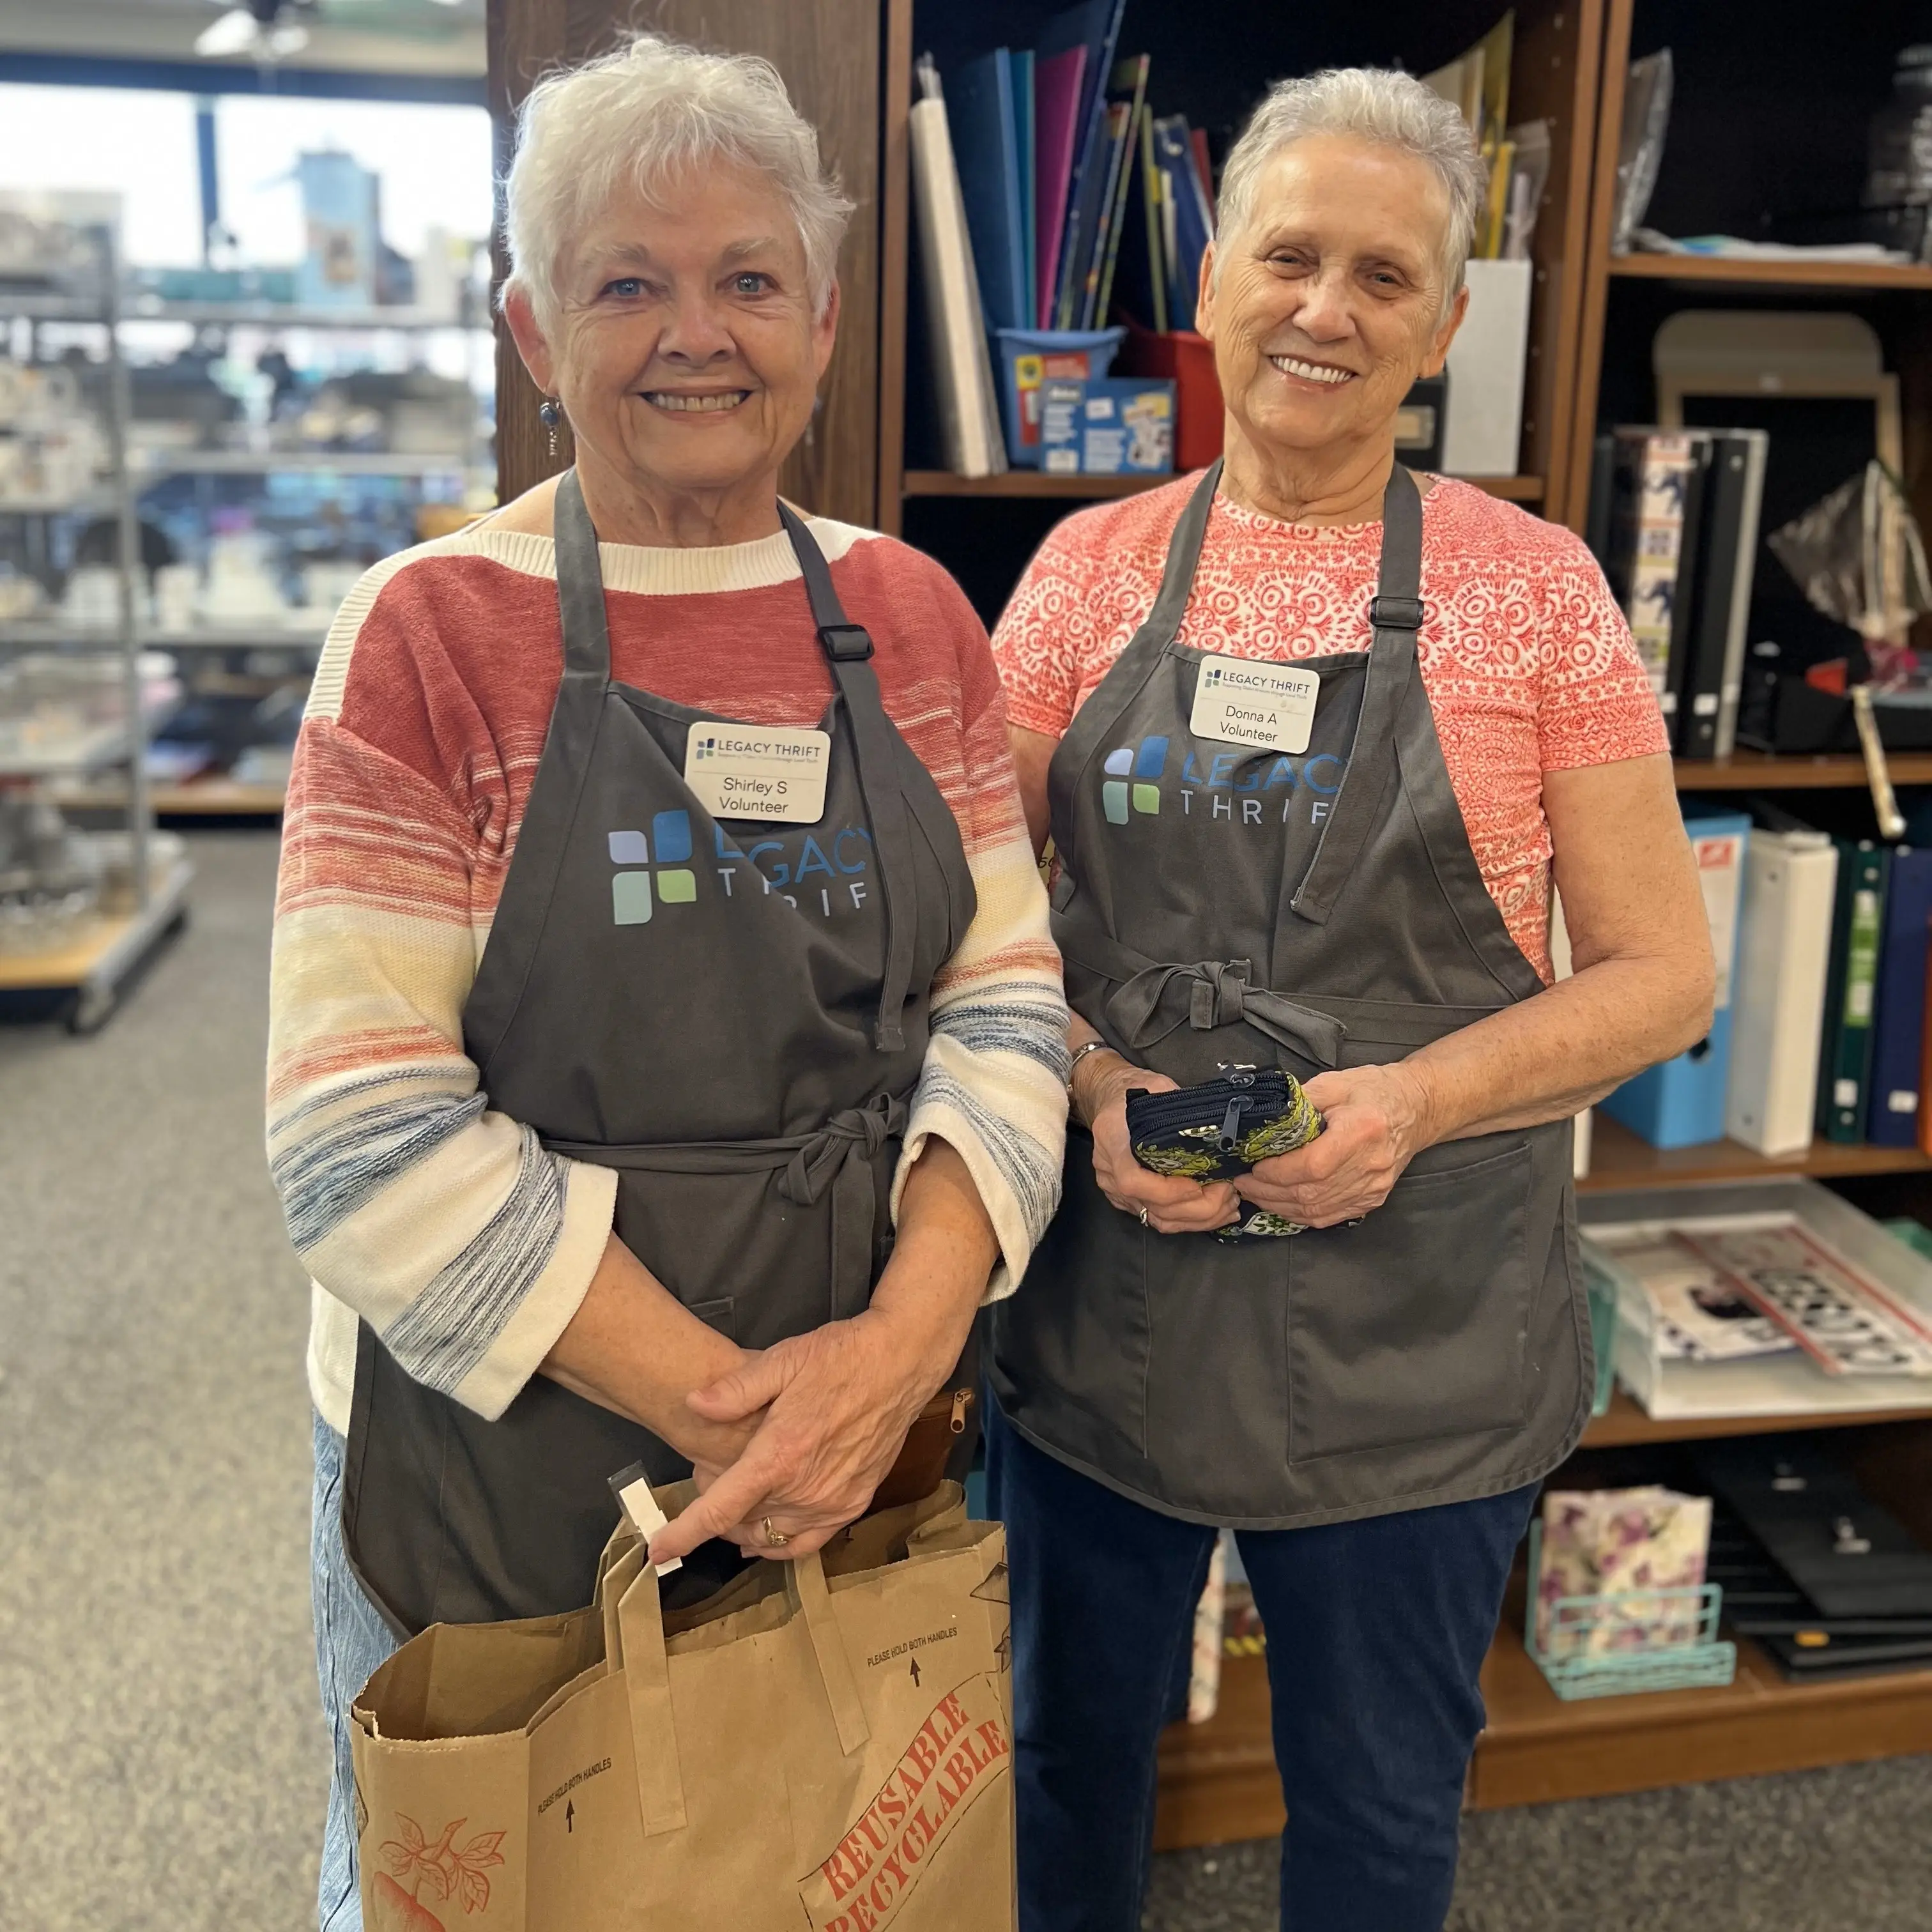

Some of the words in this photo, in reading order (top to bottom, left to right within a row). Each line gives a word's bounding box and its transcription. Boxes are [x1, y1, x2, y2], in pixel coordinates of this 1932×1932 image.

[1223, 671, 1268, 687] LEGACY
[1271, 679, 1310, 694] THRIFT
[1226, 705, 1264, 723] Donna
[1267, 713, 1277, 724] A
[1220, 721, 1278, 742] Volunteer
[718, 740, 771, 753] LEGACY
[775, 744, 821, 757] THRIFT
[1182, 751, 1347, 794] LEGAC
[723, 777, 773, 796] Shirley
[777, 781, 788, 794] S
[719, 796, 790, 814] Volunteer
[1180, 790, 1330, 825] THRIF
[867, 1650, 891, 1667] PLEASE
[891, 1643, 908, 1658] HOLD
[909, 1637, 926, 1650] BOTH
[927, 1627, 958, 1644] HANDLES
[537, 1792, 555, 1816] PLEASE
[568, 1772, 583, 1790] BOTH
[583, 1757, 611, 1781] HANDLES
[822, 1692, 971, 1903] REUSABLE
